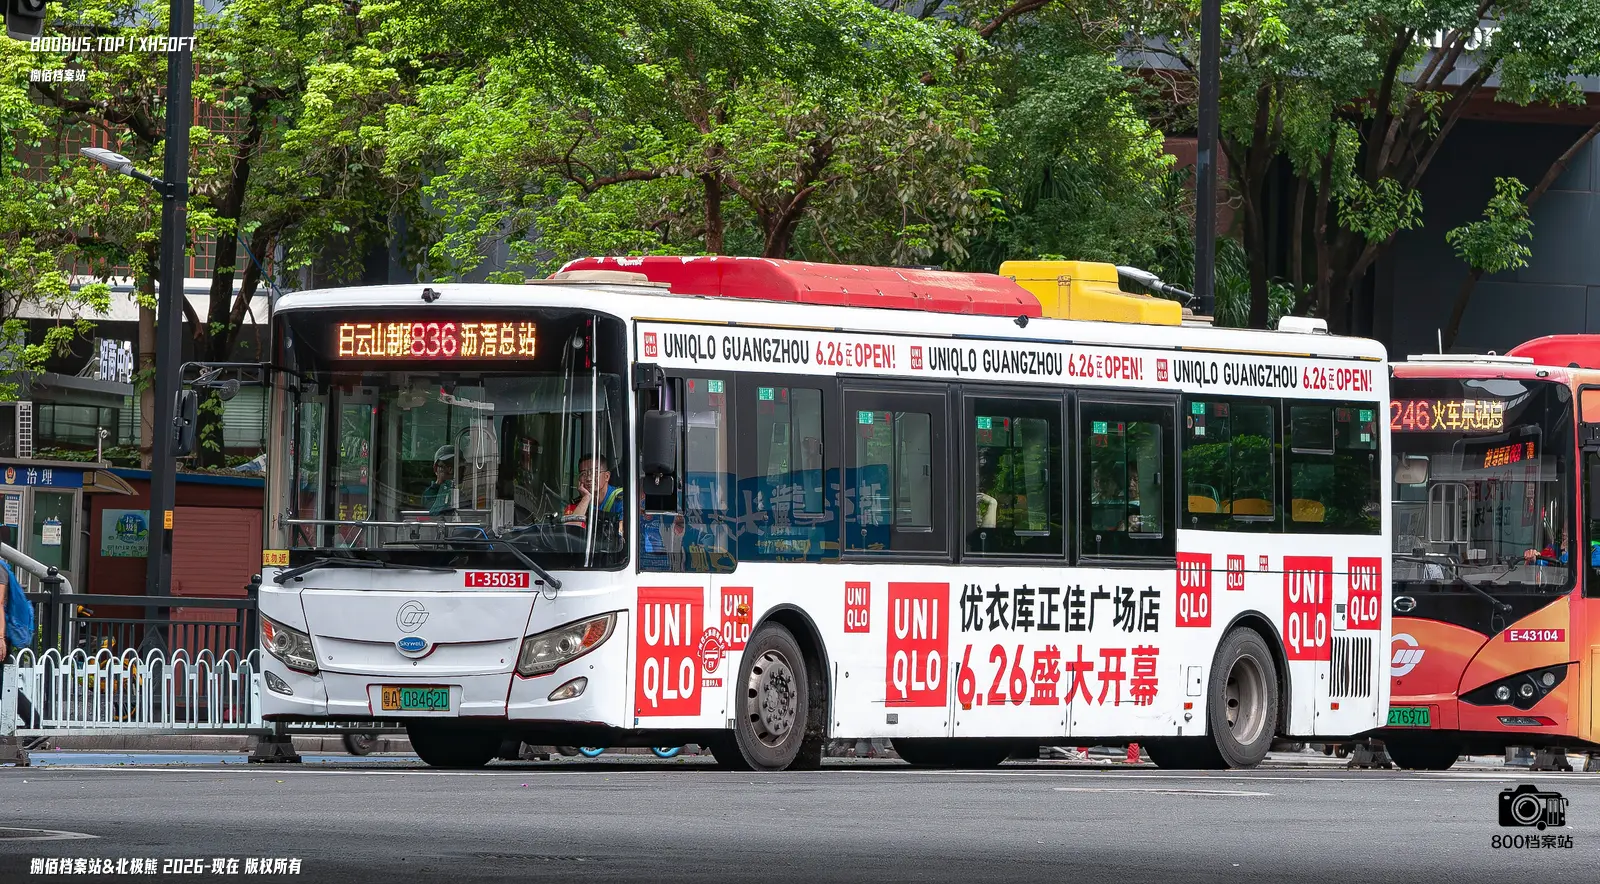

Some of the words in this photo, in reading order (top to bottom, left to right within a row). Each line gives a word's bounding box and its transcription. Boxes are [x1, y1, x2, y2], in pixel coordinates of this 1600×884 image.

[411, 322, 457, 357] 836
[663, 333, 716, 363] UNIQLO
[722, 335, 809, 365] GUANGZHOU
[815, 341, 844, 367] 6.26
[854, 343, 896, 369] OPEN!
[928, 346, 977, 376] UNIQLO
[982, 349, 1063, 376] GUANGZHOU
[1067, 353, 1095, 378] 6.26
[1104, 355, 1143, 380] OPEN!
[1173, 359, 1218, 388] UNIQLO
[1223, 362, 1298, 389] GUANGZHOU
[1302, 366, 1327, 390] 6.26
[1336, 368, 1373, 392] OPEN!
[1390, 400, 1430, 430] 246
[27, 468, 53, 484] 治理
[469, 573, 525, 587] 1-35031
[1180, 562, 1206, 587] UNI
[1229, 559, 1242, 571] UNI
[1351, 566, 1376, 591] UNI
[1228, 573, 1243, 588] QLO
[1289, 570, 1324, 604] UNI
[847, 588, 867, 606] UNI
[959, 583, 1161, 633] 优衣库正佳广场店
[1179, 592, 1208, 622] QLO
[1350, 596, 1378, 625] QLO
[644, 603, 692, 646] UNI
[723, 621, 750, 647] QLO
[847, 609, 868, 630] QLO
[894, 598, 938, 640] UNI
[1288, 612, 1326, 653] QLO
[1510, 629, 1559, 642] E-43104
[643, 656, 695, 708] QLO
[892, 650, 941, 699] QLO
[957, 643, 1160, 706] 6.26盛大开幕
